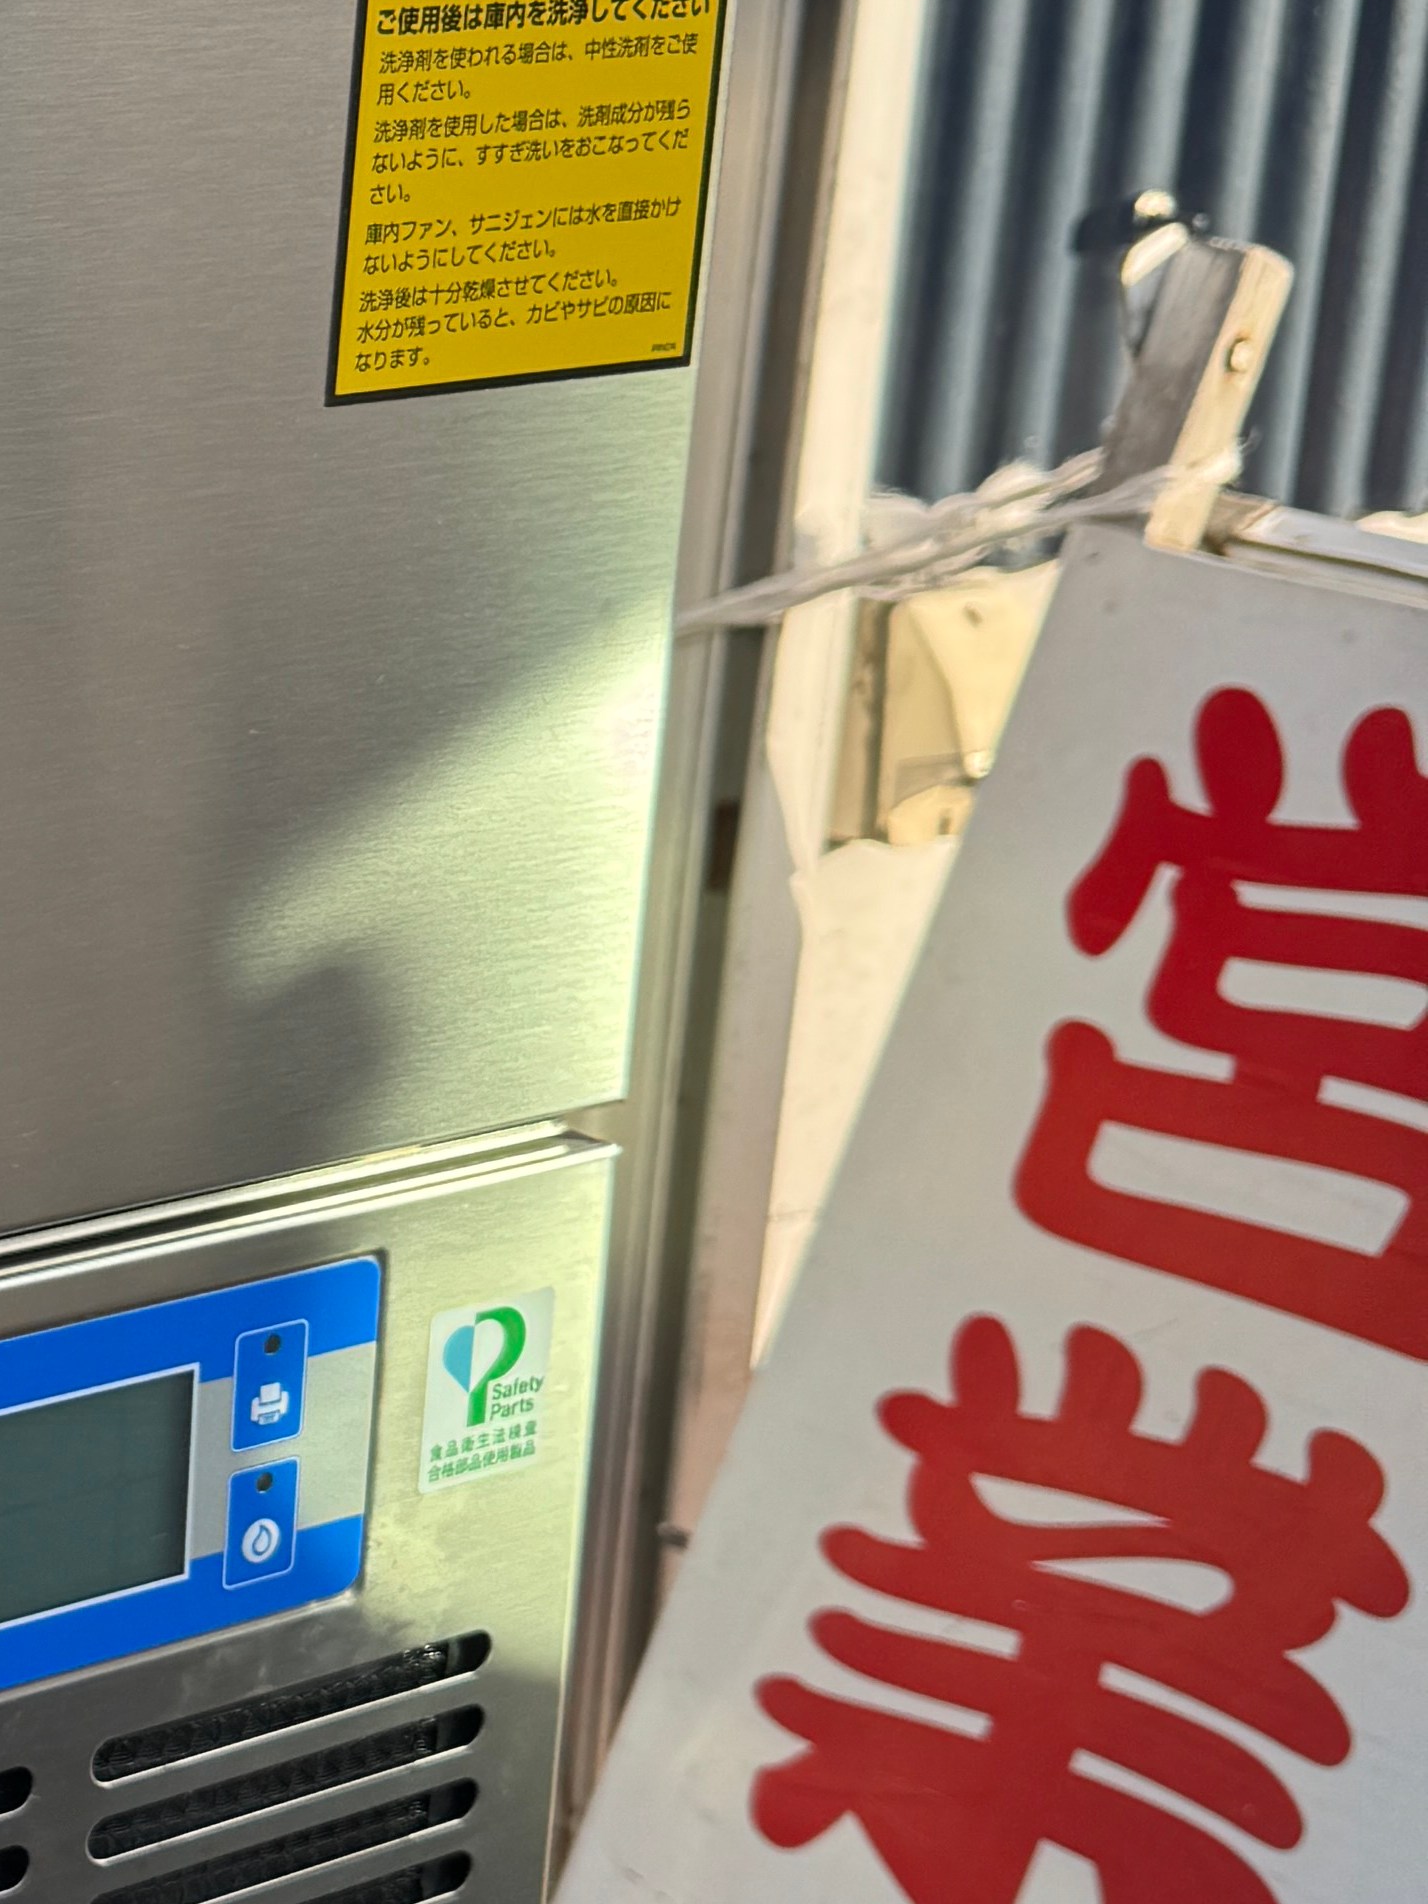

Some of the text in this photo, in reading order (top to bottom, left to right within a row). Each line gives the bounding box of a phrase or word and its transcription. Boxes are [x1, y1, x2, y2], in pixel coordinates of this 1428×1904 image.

[377, 79, 471, 106] 用ください。
[369, 182, 411, 205] さい。
[362, 237, 557, 274] ないようにしてください。
[359, 268, 618, 313] 洗浄後は十分乾燥させてください。
[354, 346, 430, 373] なります。
[492, 1375, 545, 1401] Safety
[490, 1397, 535, 1422] Parts
